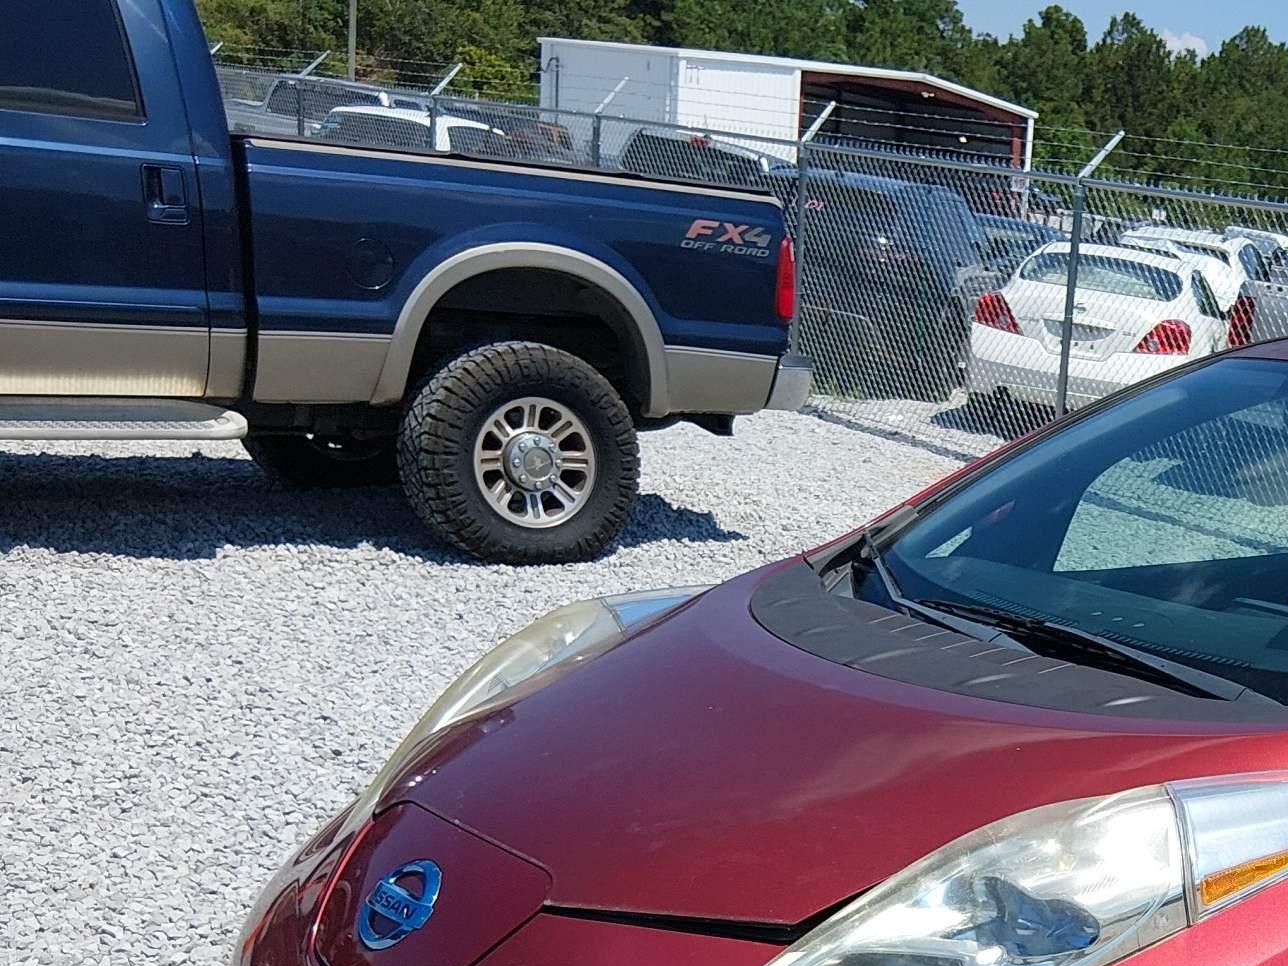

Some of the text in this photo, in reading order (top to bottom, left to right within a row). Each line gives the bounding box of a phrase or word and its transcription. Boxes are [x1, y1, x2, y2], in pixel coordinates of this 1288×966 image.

[680, 239, 770, 257] OFF ROAD
[685, 219, 772, 248] FX4
[367, 884, 418, 921] SSAN
